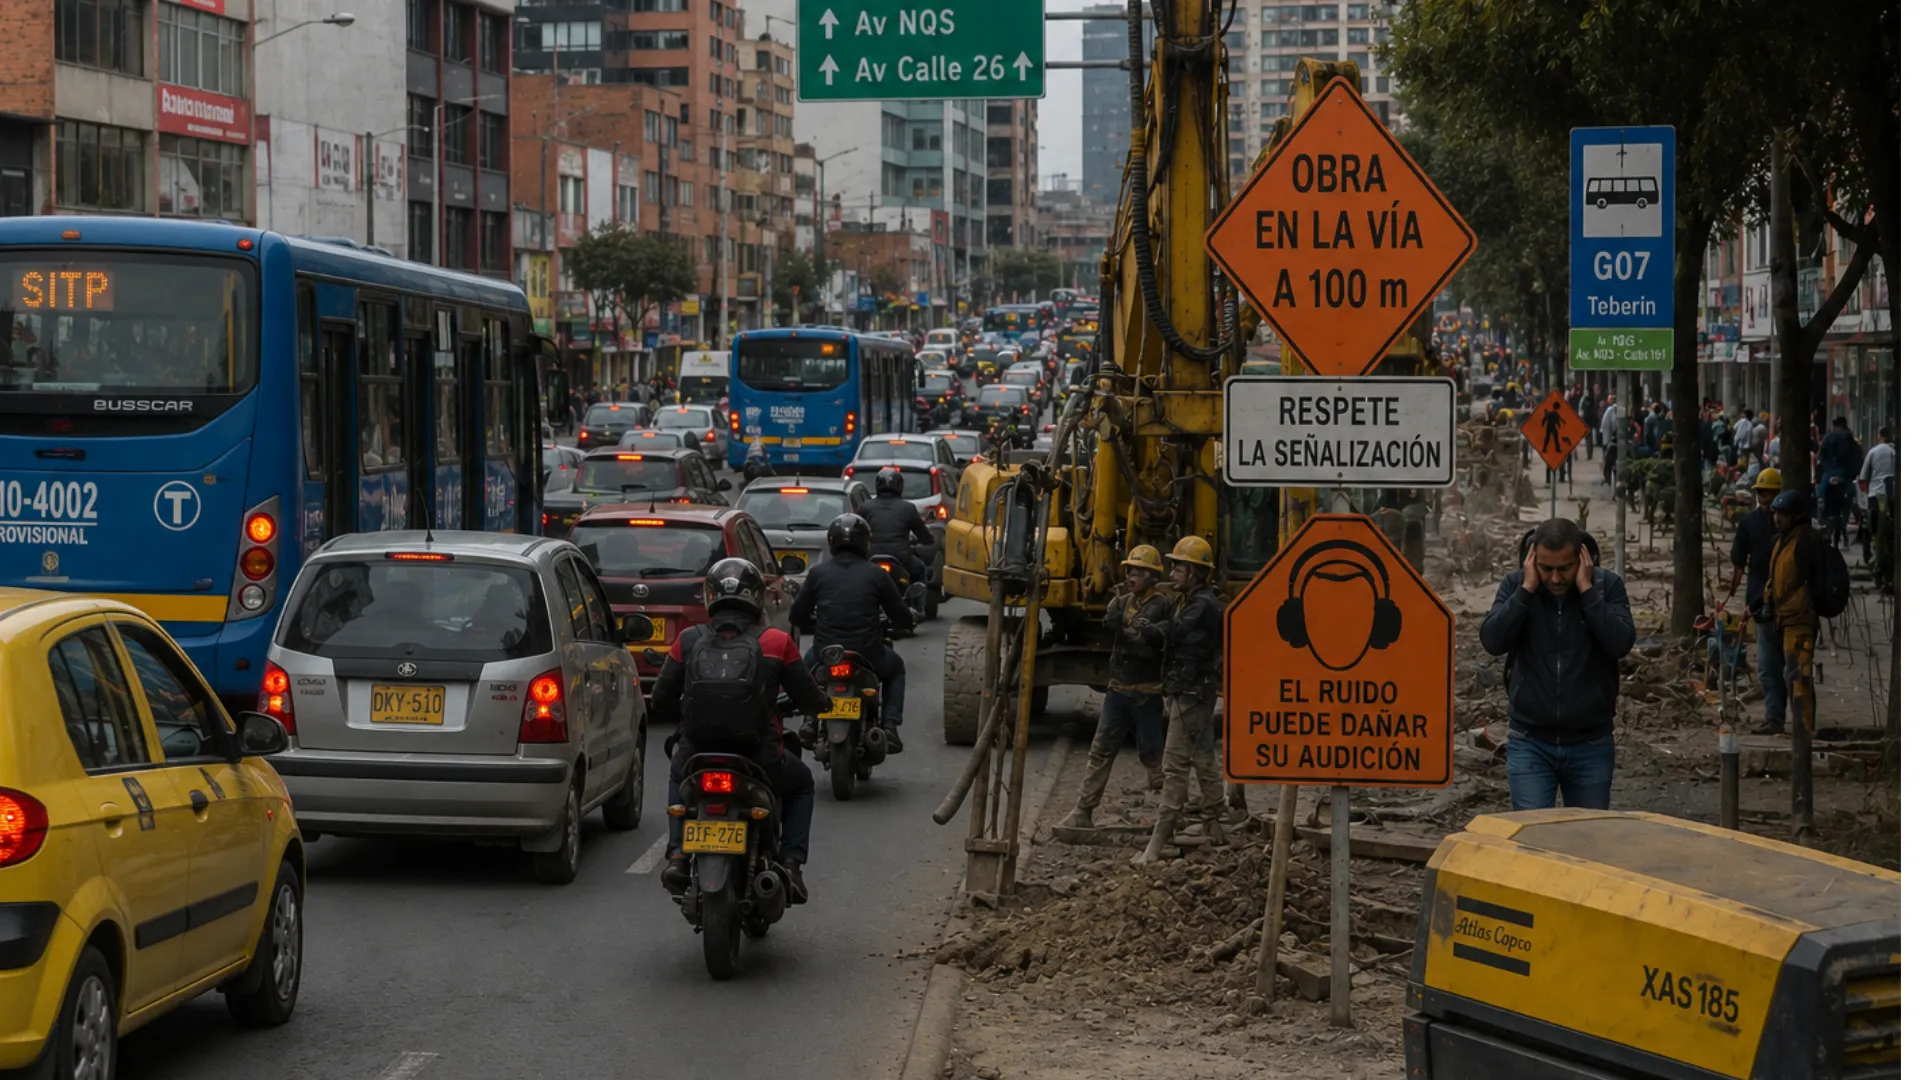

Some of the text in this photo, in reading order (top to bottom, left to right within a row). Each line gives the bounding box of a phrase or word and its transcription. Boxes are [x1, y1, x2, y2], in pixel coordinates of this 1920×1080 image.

[854, 8, 956, 36] Av NQS
[854, 54, 1005, 83] Av Calle 26
[1291, 153, 1387, 193] OBRA
[1256, 200, 1424, 249] EN LA VÍA
[1593, 250, 1651, 281] G07
[22, 271, 108, 308] SITP
[1272, 268, 1408, 309] A 100 m
[1587, 295, 1656, 316] Teberin
[93, 400, 194, 411] BUSSCAR
[1279, 396, 1400, 426] RESPETE
[1238, 433, 1441, 468] LA SEÑALIZACIÓN
[373, 691, 442, 715] DKY-510
[1279, 679, 1398, 705] EL RUIDO
[1248, 708, 1428, 738] PUEDE DAÑAR
[1256, 740, 1421, 771] SU AUDICIÓN
[1454, 916, 1532, 953] Atlas Copco
[1640, 964, 1740, 1024] XAS 185
